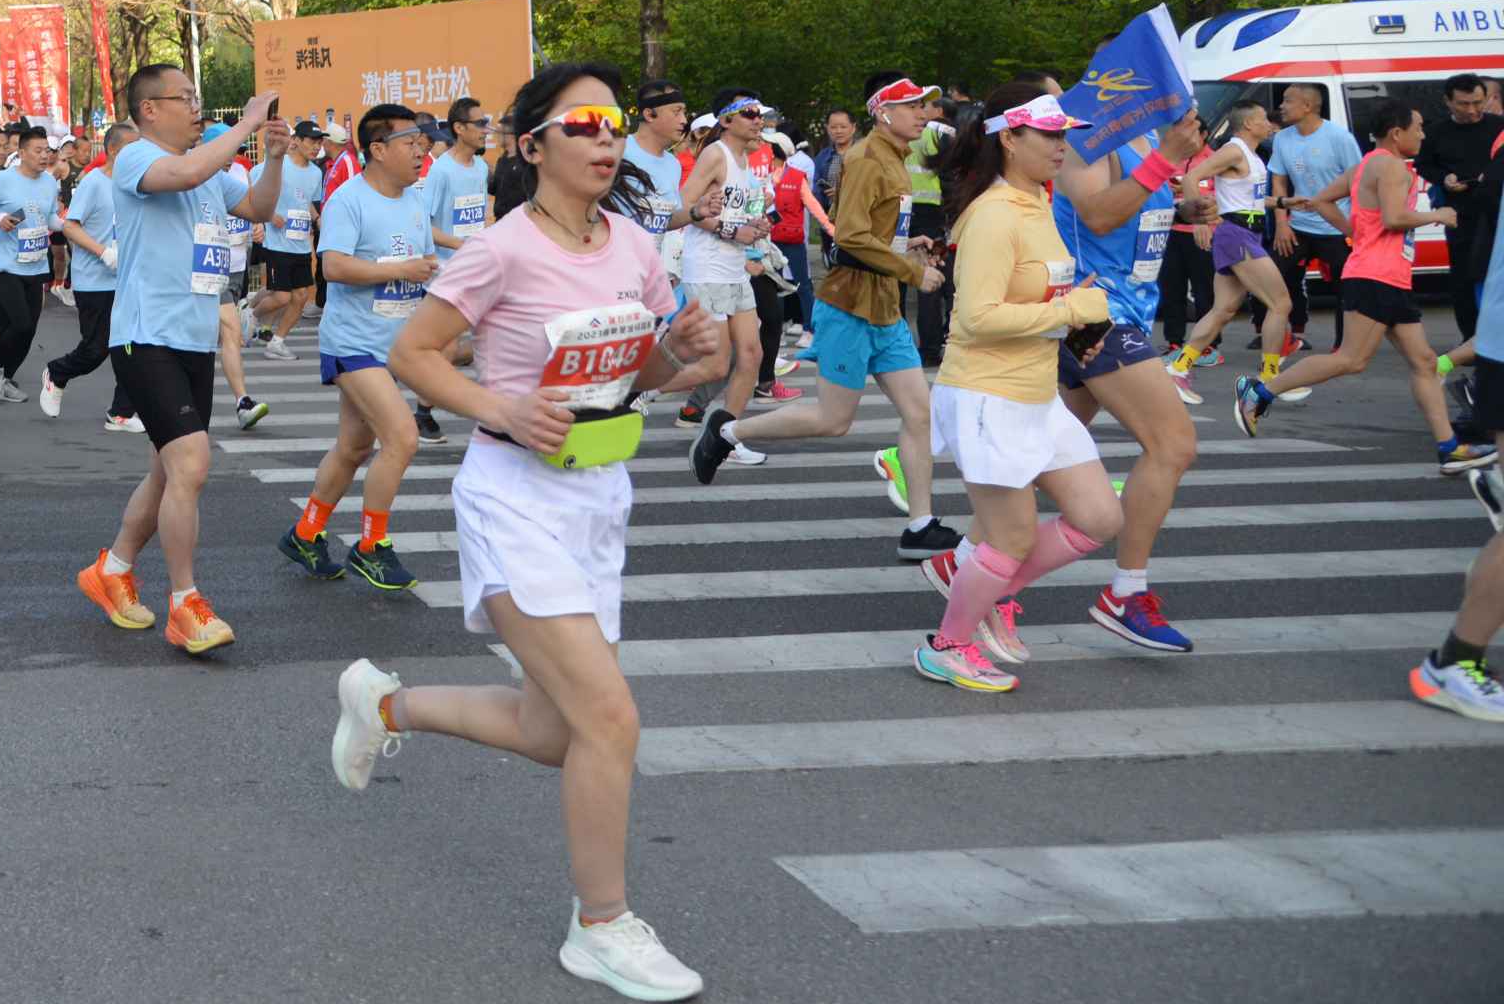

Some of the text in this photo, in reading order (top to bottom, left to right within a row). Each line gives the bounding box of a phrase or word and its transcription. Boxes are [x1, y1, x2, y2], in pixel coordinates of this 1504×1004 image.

[361, 66, 472, 107] 激情马拉松
[225, 218, 245, 232] 3643
